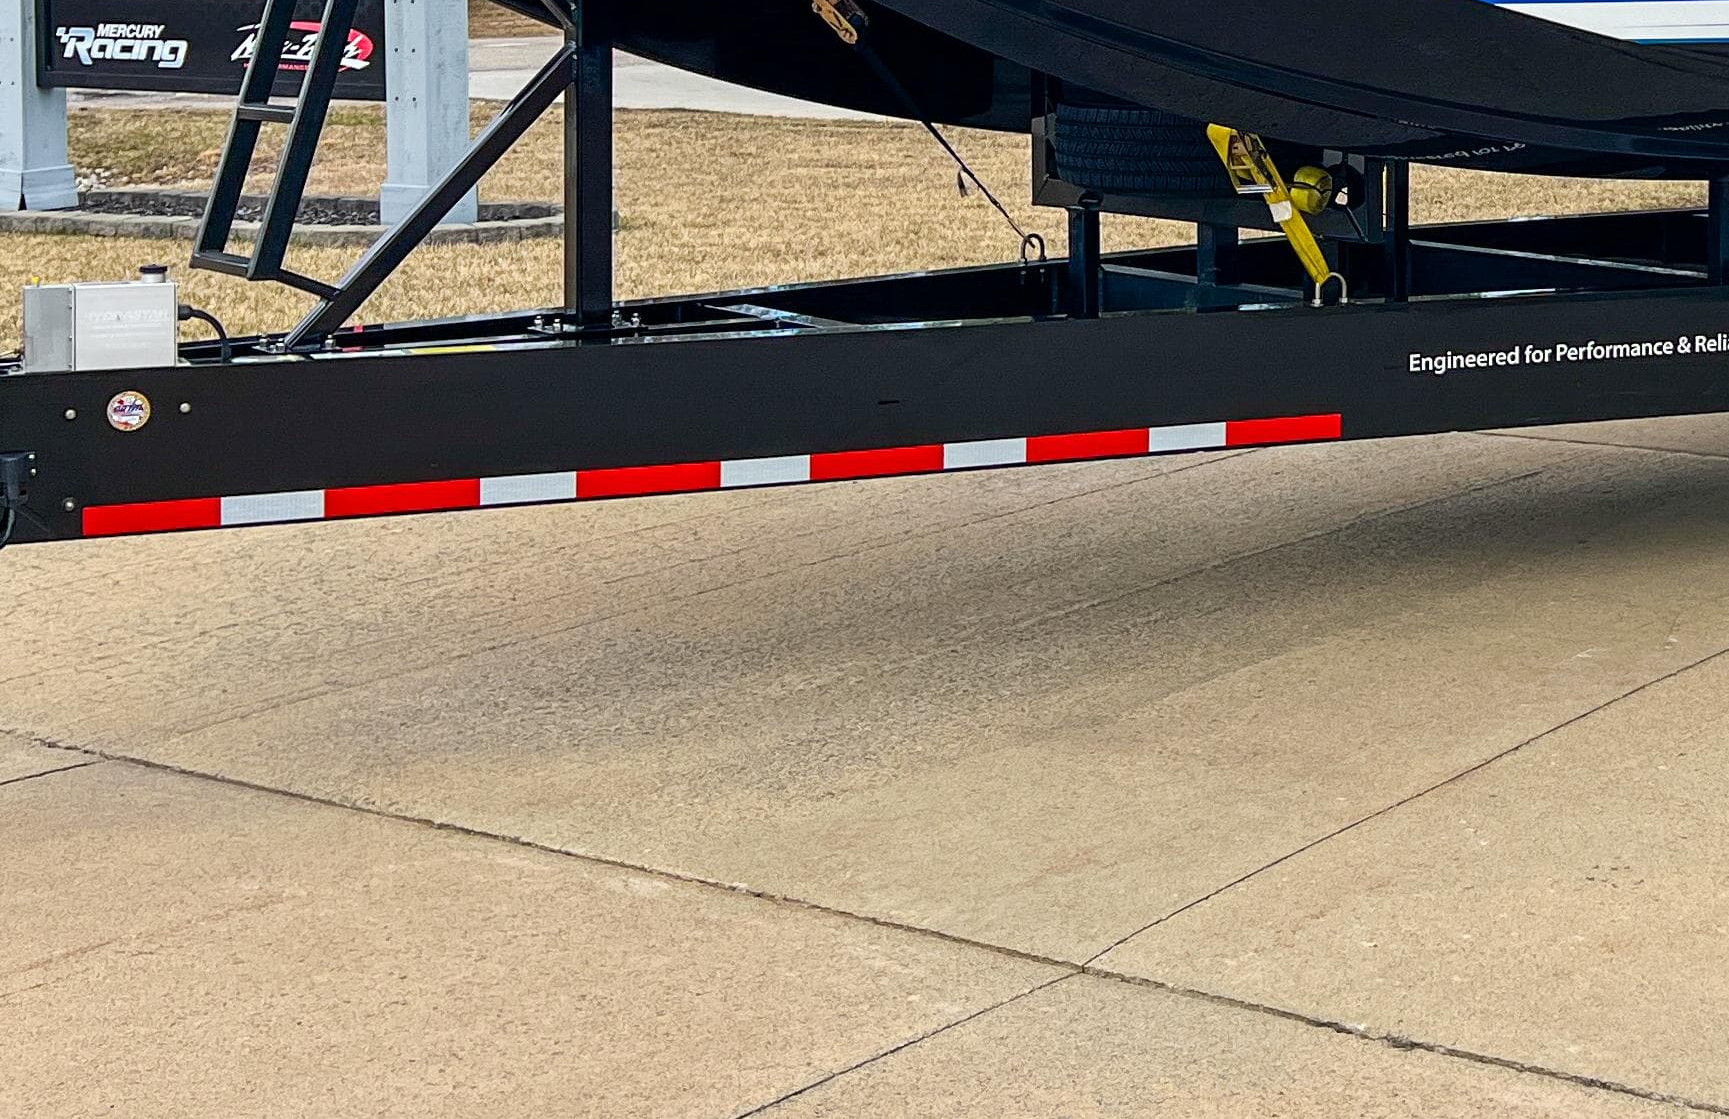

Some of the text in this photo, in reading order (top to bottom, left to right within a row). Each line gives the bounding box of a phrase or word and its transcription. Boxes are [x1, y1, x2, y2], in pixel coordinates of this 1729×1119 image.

[63, 27, 188, 68] Racing
[97, 23, 165, 38] MERCURY
[1409, 346, 1519, 374] Engineered
[1525, 345, 1551, 363] for
[1556, 339, 1673, 362] Performance
[1677, 336, 1691, 353] &
